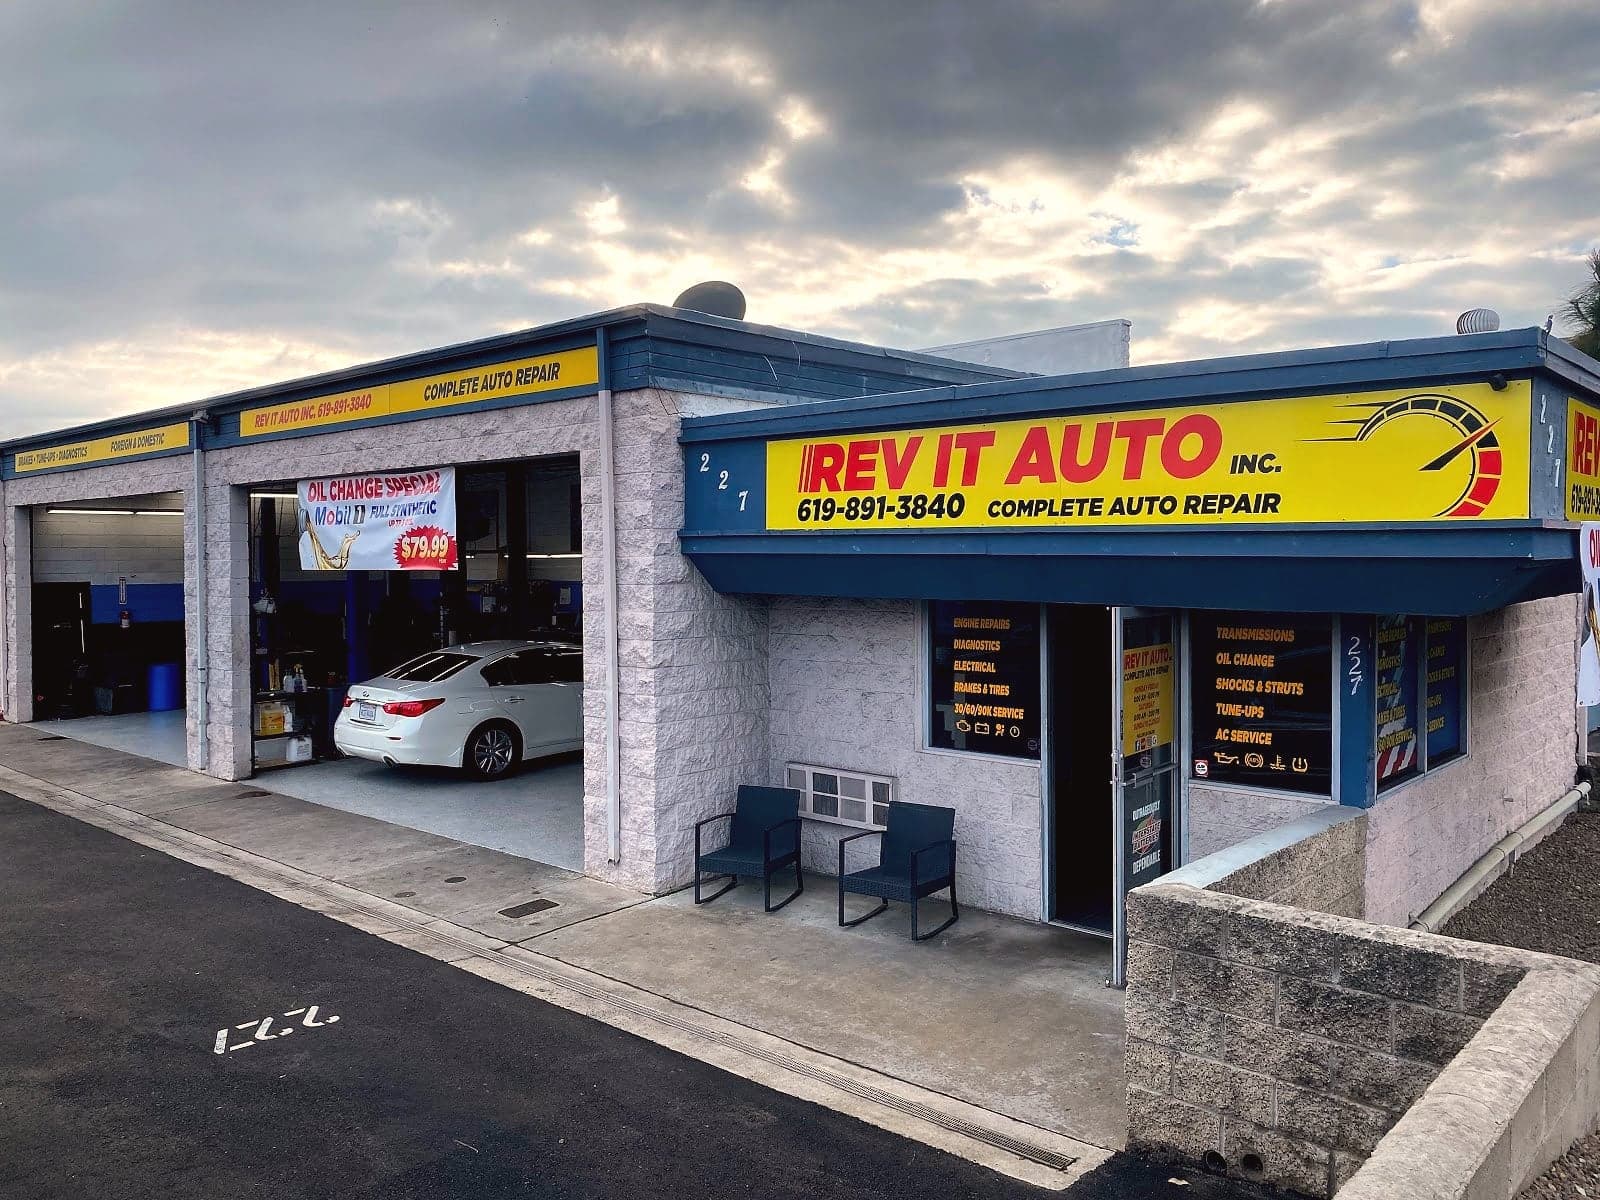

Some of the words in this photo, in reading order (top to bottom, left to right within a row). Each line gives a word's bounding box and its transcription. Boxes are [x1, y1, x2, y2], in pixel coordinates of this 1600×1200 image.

[424, 377, 480, 401] COMPLETE
[481, 370, 513, 391] AUTO
[515, 362, 561, 387] REPAIR
[255, 413, 270, 428] REV
[270, 411, 279, 425] IT
[279, 409, 300, 423] AUTO
[300, 406, 317, 421] INC.
[317, 393, 372, 417] 619-891-3840
[110, 438, 132, 452] FOREIGN
[137, 433, 165, 448] DOMESTIC
[58, 446, 88, 460] DIAGNOSTICS
[798, 436, 923, 493] REV
[933, 430, 996, 488] IT
[1004, 414, 1223, 485] AUTO
[1230, 453, 1282, 475] INC.
[308, 481, 327, 503] OIL
[330, 477, 384, 501] CHANGE
[385, 471, 441, 497] SPECIAL
[315, 505, 350, 526] Mobil
[370, 505, 389, 519] FULL
[391, 500, 437, 517] SYNTHETIC
[797, 493, 965, 522] 619-891-3840
[987, 497, 1104, 518] COMPLETE
[1108, 495, 1177, 516] AUTO
[1184, 493, 1281, 515] REPAIR
[401, 535, 449, 561] $79.99
[953, 617, 979, 628] ENGINE
[980, 618, 1011, 630] REPAIRS
[1216, 627, 1295, 642] TRANSMISSIONS
[953, 638, 1001, 651] DIAGNOSTICS
[953, 660, 996, 673] ELECTRICAL
[1123, 651, 1140, 670] REV
[1141, 651, 1149, 667] IT
[1150, 648, 1169, 666] AUTO
[1216, 652, 1232, 665] OIL
[1234, 653, 1275, 668] CHANGE
[954, 681, 982, 694] BRAKES
[983, 683, 988, 694] &
[989, 684, 1010, 696] TIRES
[1216, 677, 1254, 692] SHOCKS
[1256, 680, 1263, 693] &
[1264, 681, 1304, 695] STRUTS
[993, 706, 1024, 719] SERVICE
[1216, 703, 1264, 718] TUNE-UPS
[1215, 728, 1229, 741] AC
[1231, 730, 1272, 745] SERVICE
[1133, 850, 1160, 875] DEPENDABLE
